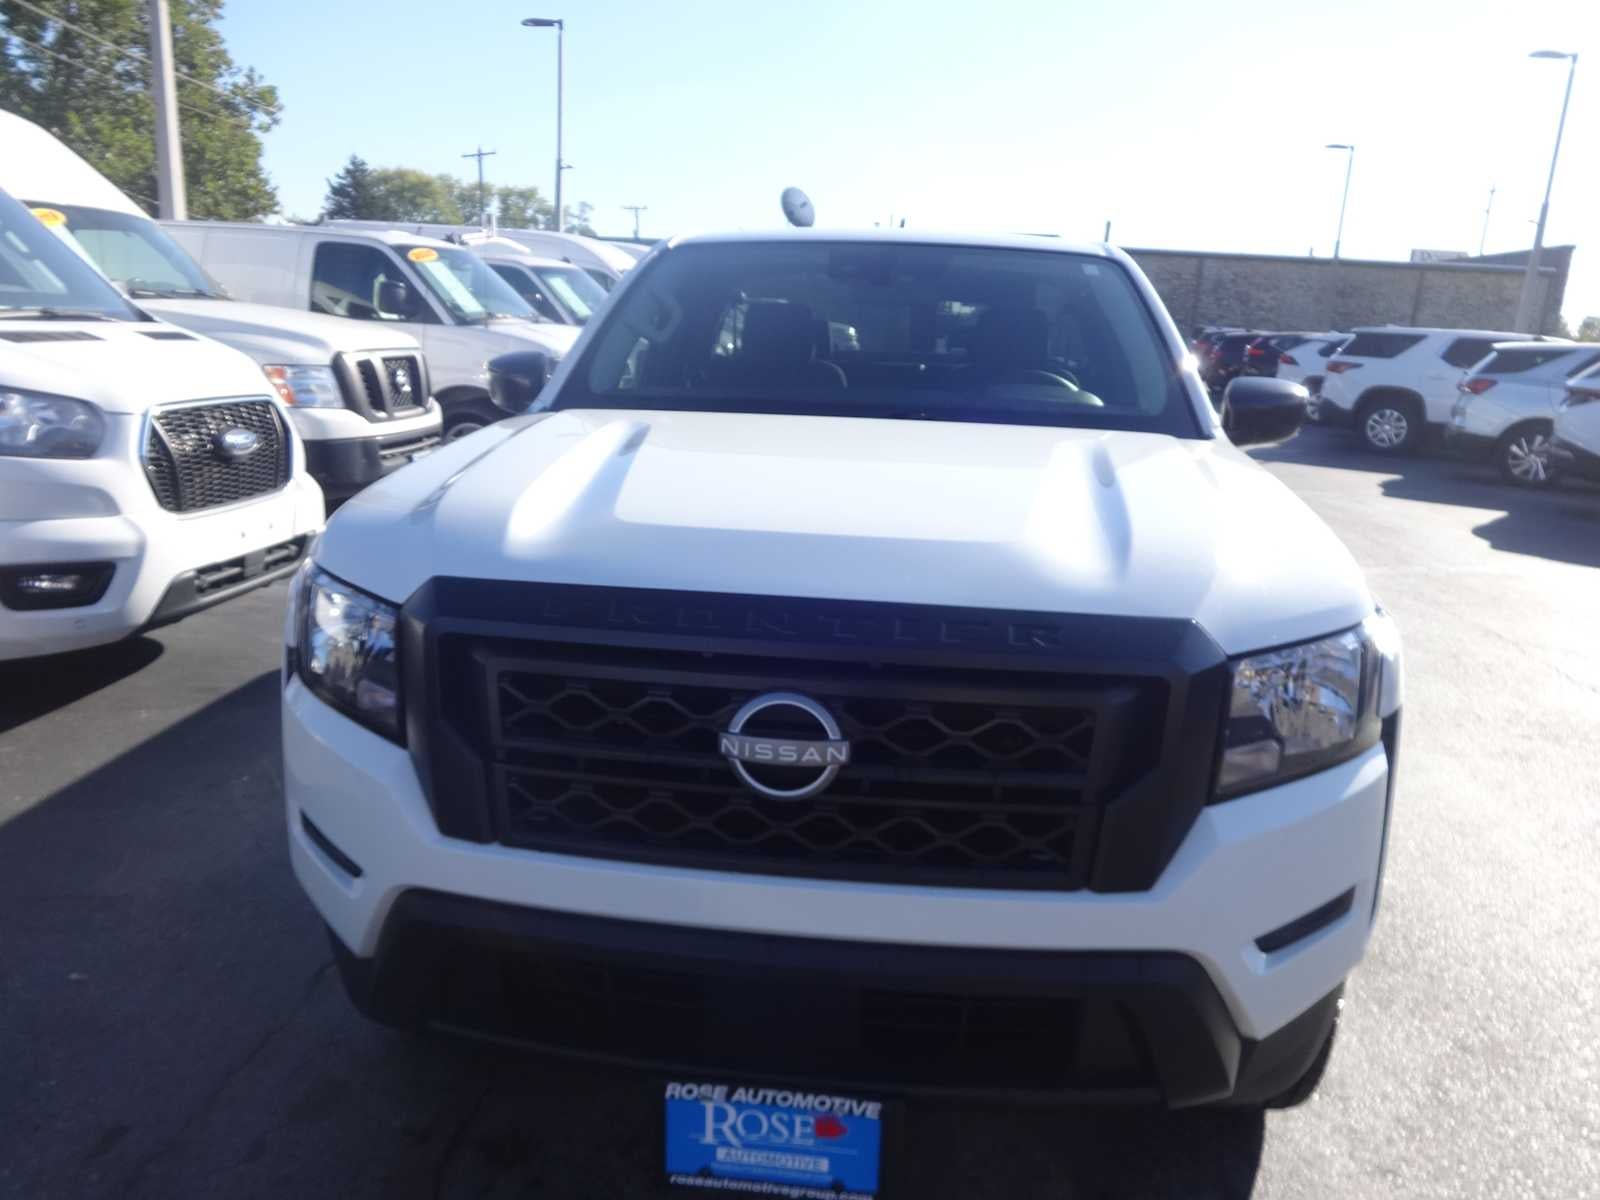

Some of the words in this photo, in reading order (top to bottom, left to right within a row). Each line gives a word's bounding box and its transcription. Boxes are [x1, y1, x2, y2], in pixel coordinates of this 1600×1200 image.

[720, 737, 846, 763] NISSAN
[664, 1082, 728, 1101] ROSE
[732, 1087, 882, 1119] AUTOMOTIVE
